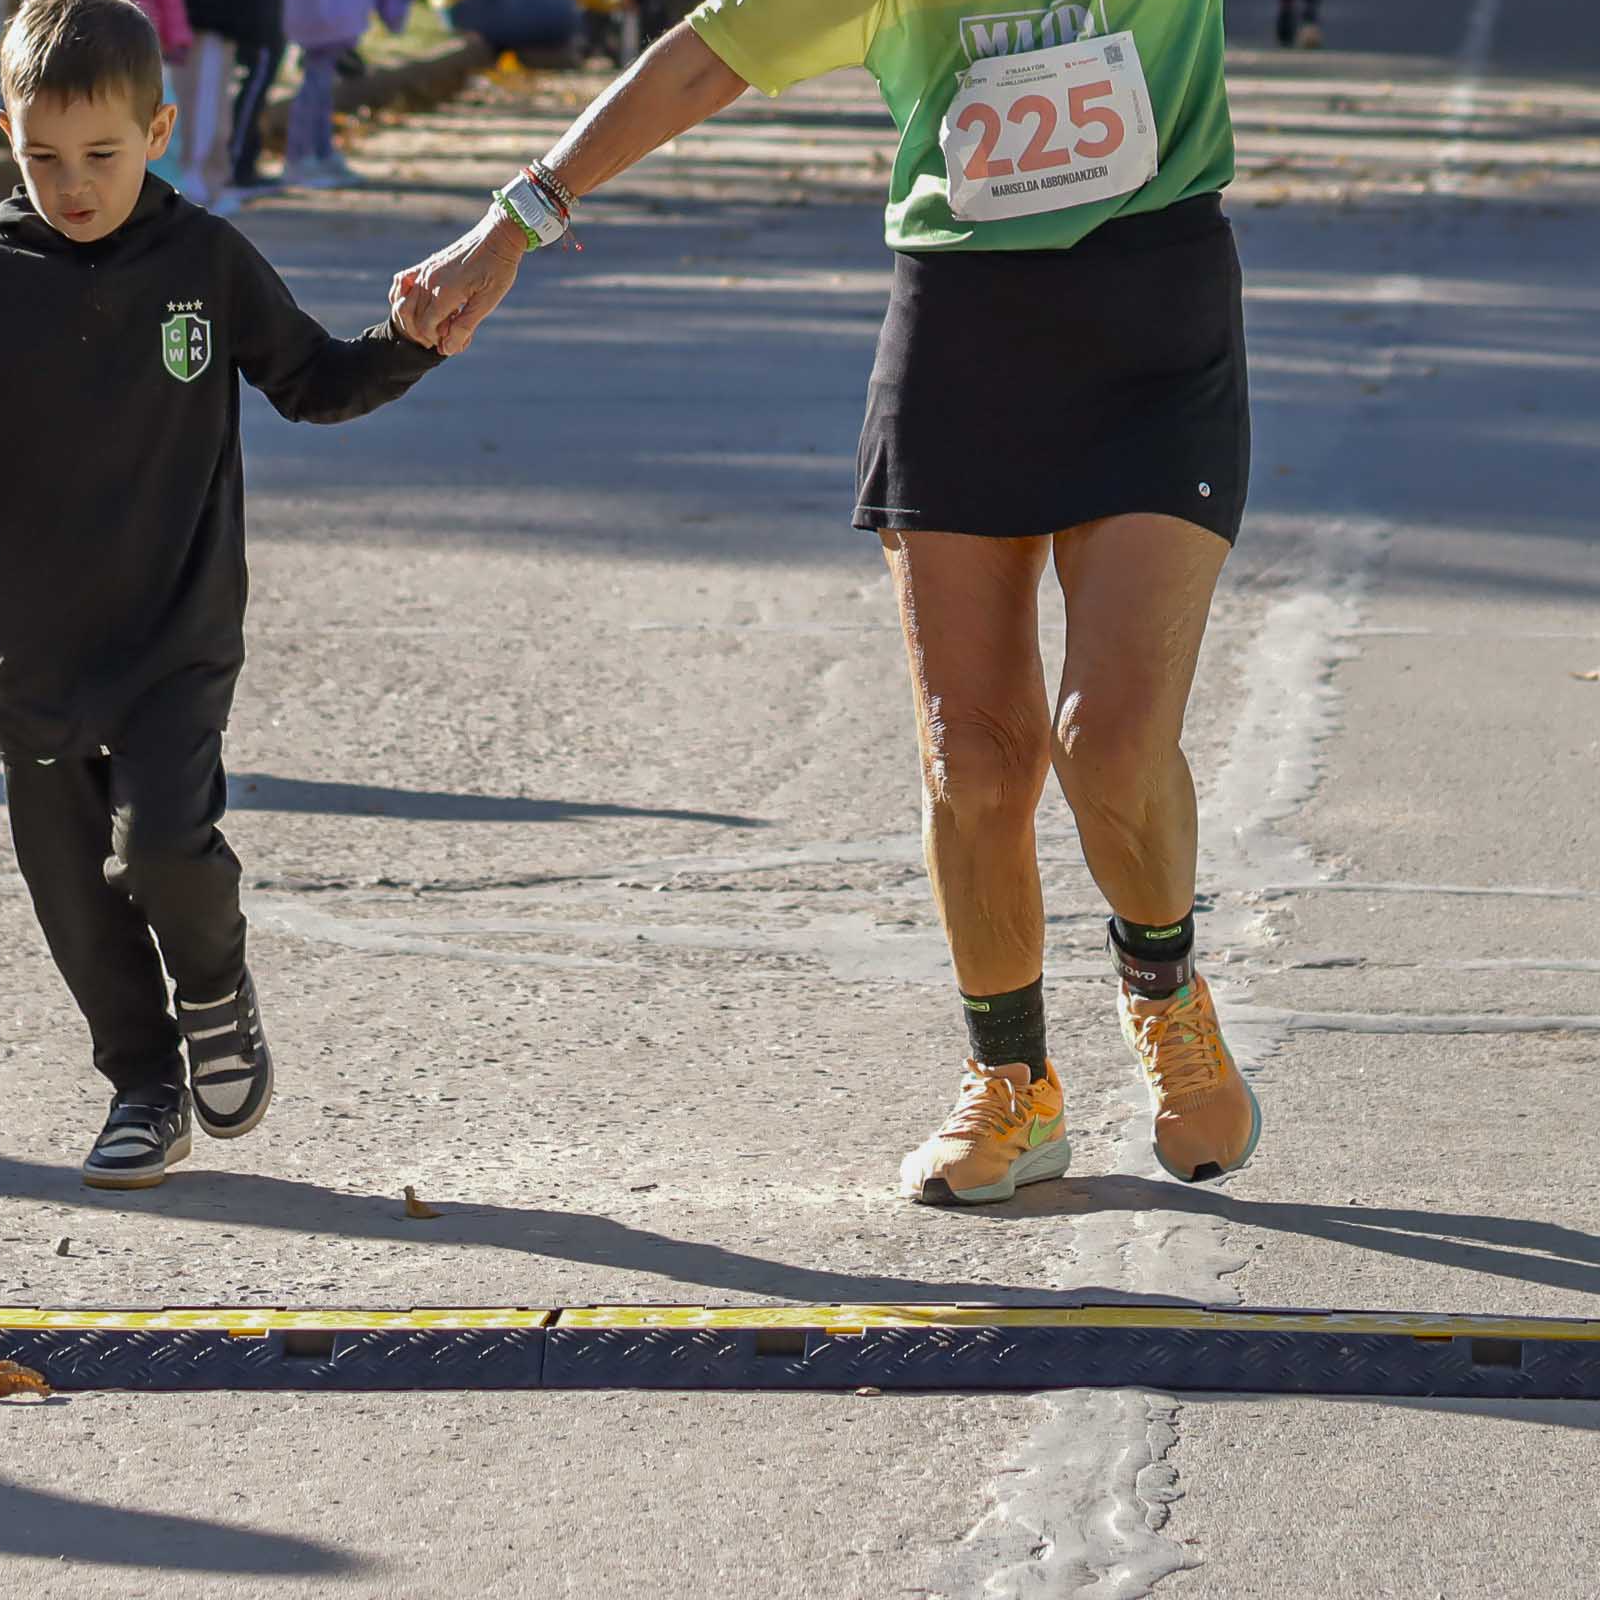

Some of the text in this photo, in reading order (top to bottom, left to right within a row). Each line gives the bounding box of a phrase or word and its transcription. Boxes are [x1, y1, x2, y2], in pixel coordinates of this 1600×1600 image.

[956, 80, 1125, 181] 225
[991, 165, 1109, 198] MARISELDA ABBONDANZIERI
